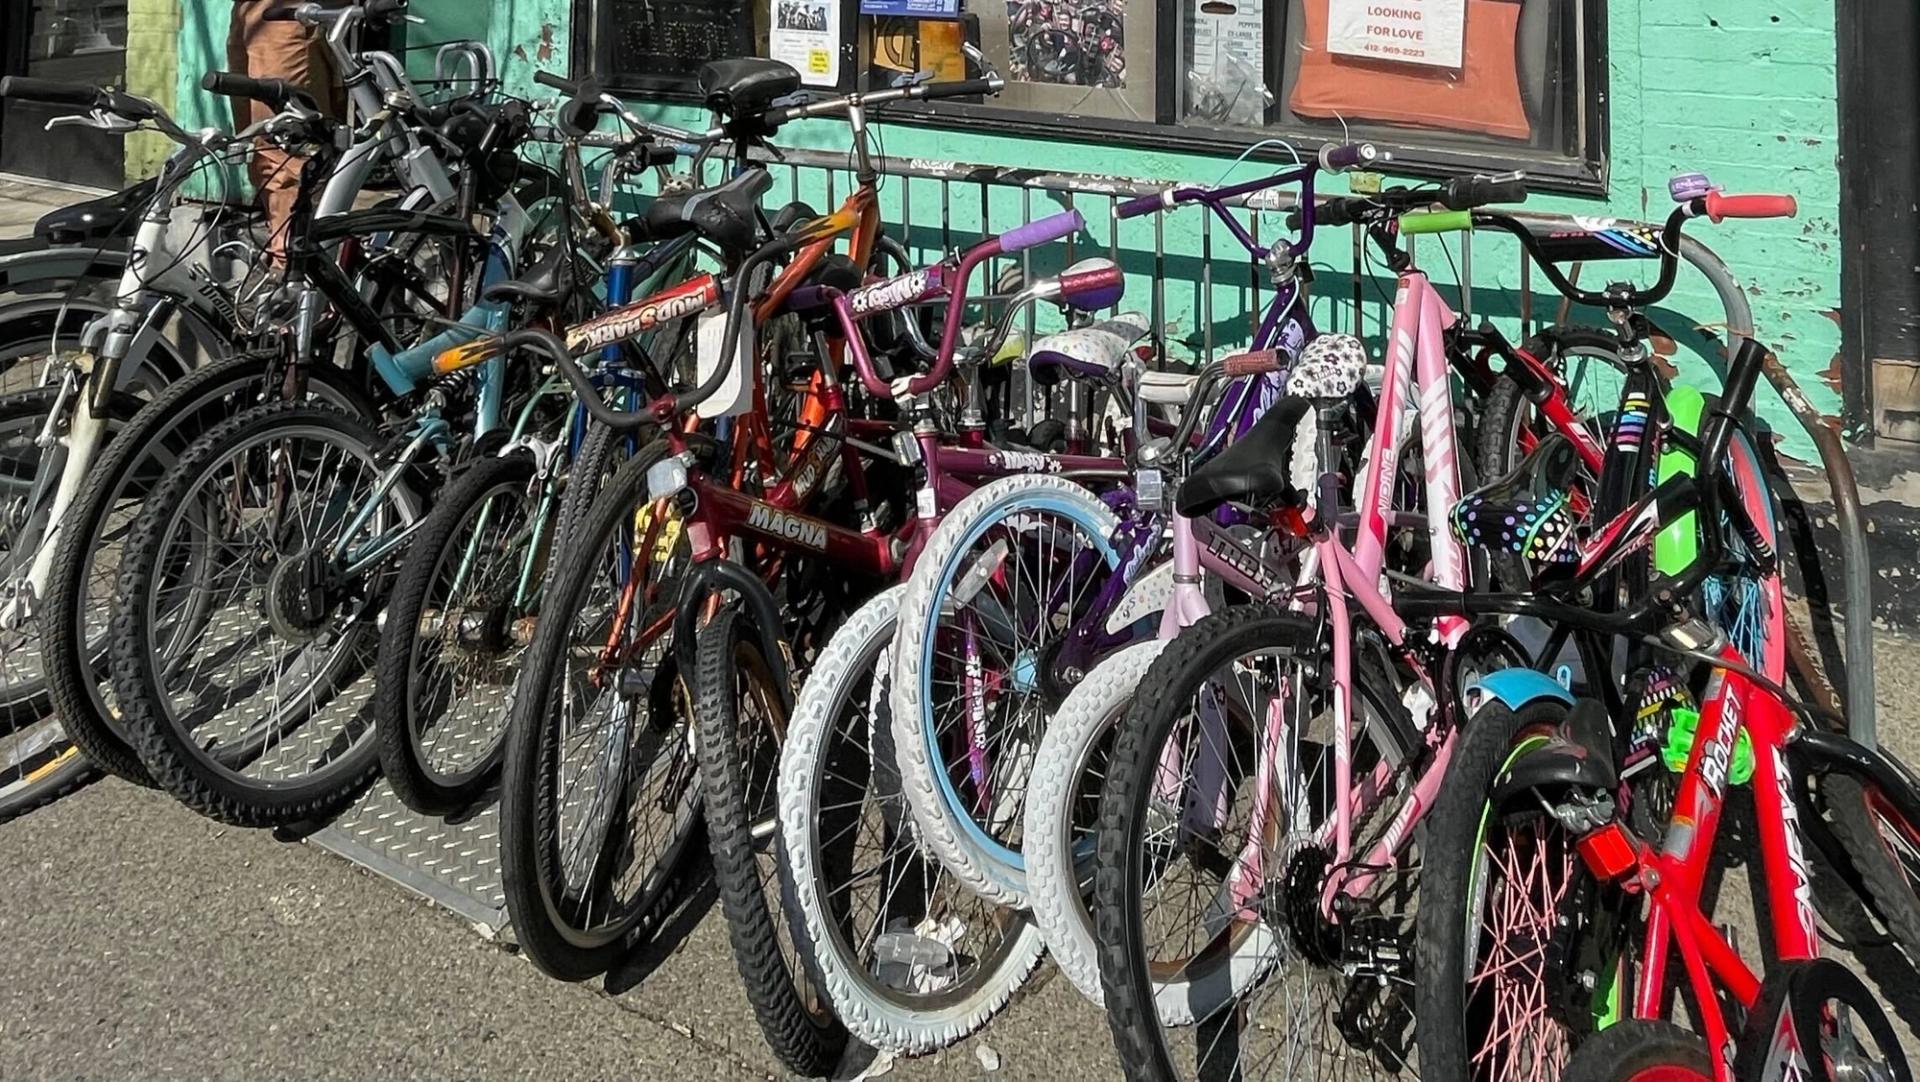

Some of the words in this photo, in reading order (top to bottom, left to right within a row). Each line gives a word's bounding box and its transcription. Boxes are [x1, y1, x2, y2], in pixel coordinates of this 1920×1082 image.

[1367, 6, 1422, 20] LOOKING
[1366, 25, 1390, 37] FOR
[1391, 29, 1424, 40] LOVE
[747, 505, 827, 550] MAGNA
[1702, 682, 1742, 801] ROCKET
